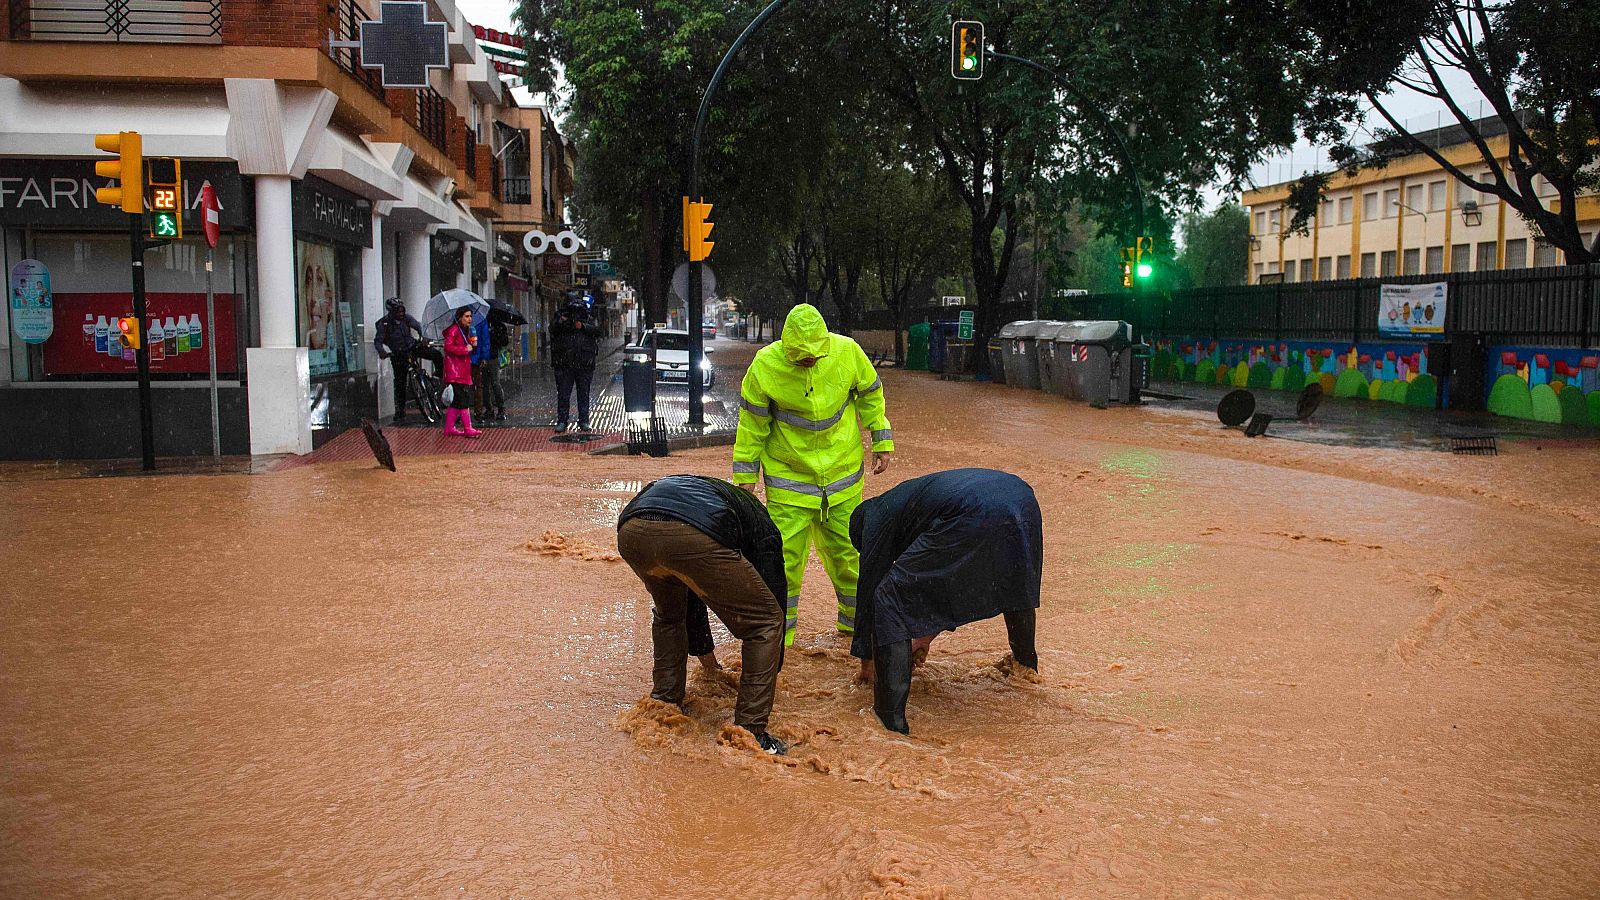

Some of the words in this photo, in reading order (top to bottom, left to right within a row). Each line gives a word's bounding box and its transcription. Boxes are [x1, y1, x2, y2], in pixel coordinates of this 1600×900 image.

[0, 177, 224, 210] FARMIA
[155, 190, 174, 207] 22
[315, 192, 364, 233] FARMACIA
